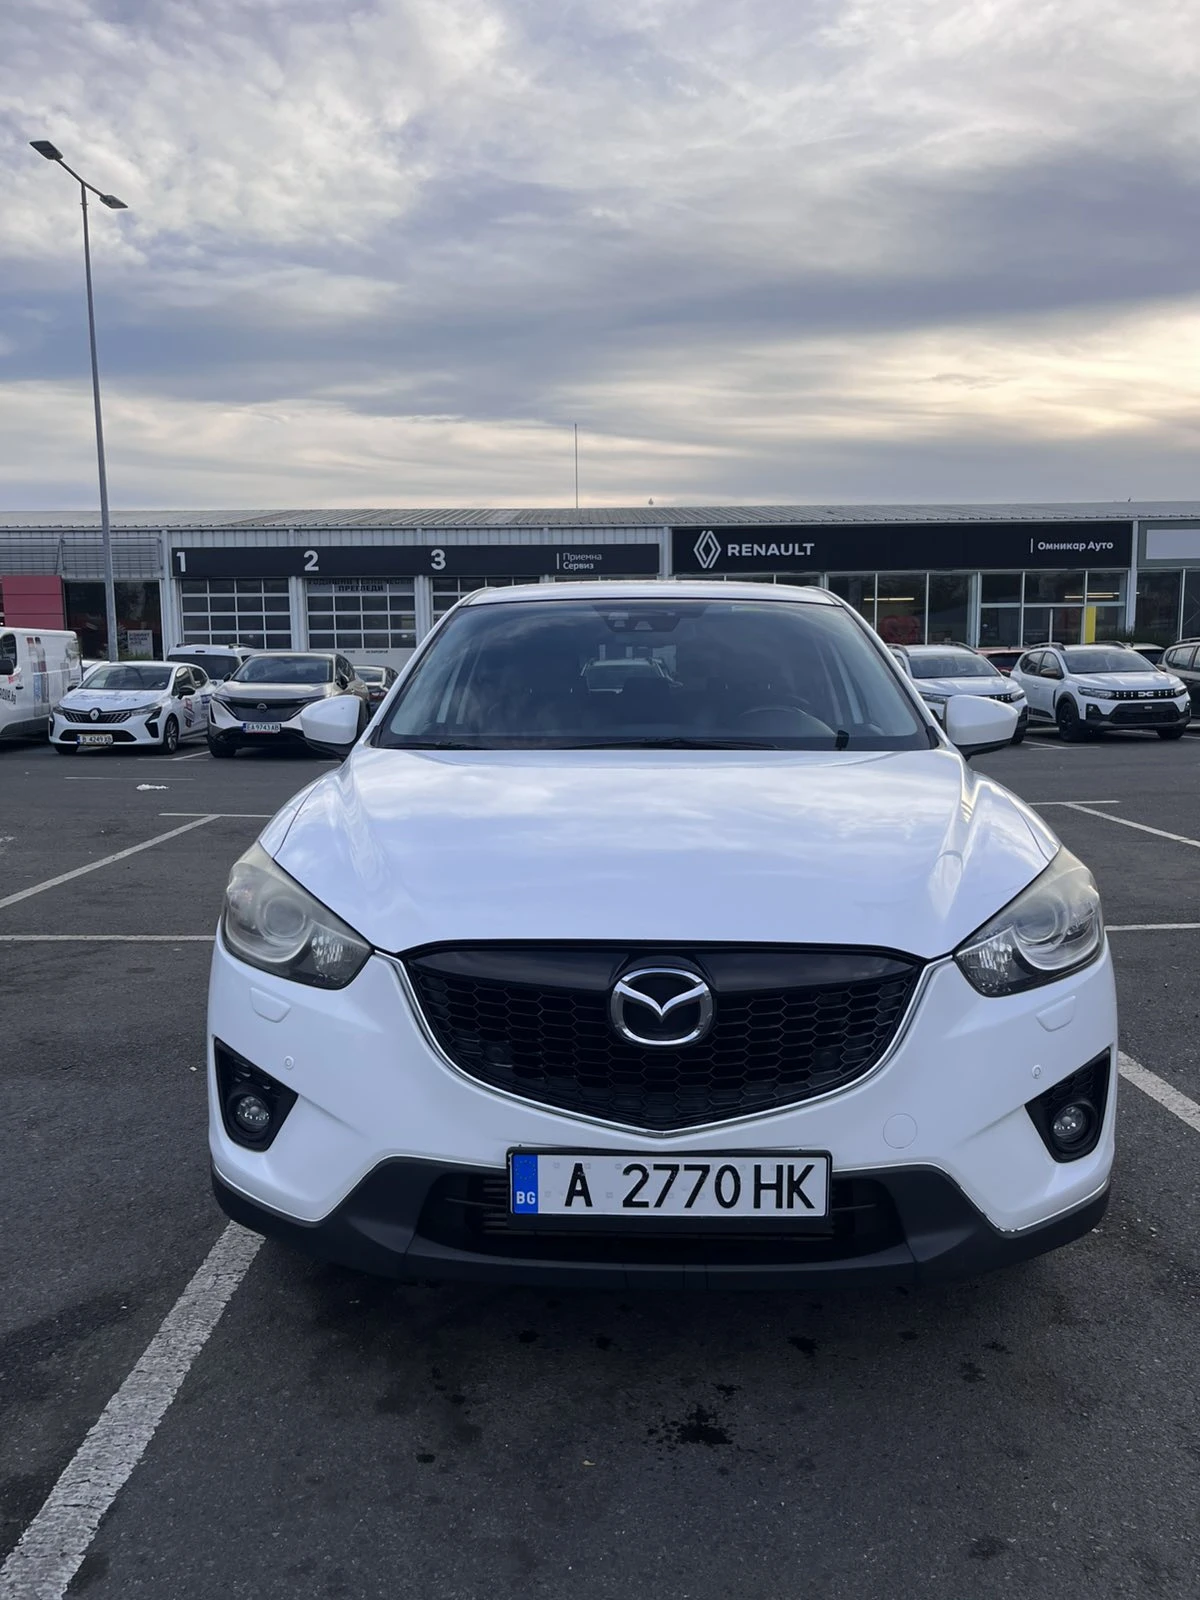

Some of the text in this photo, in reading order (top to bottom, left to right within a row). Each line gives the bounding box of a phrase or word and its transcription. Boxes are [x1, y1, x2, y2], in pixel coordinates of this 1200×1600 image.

[727, 543, 815, 557] RENAULT
[1037, 541, 1114, 552] Омникар Ауто
[176, 551, 187, 573] 1
[303, 550, 319, 572] 2
[430, 549, 446, 570] 3
[563, 553, 602, 562] Приемна
[563, 562, 594, 571] Сервиз
[564, 1163, 816, 1210] A 2770 HK
[516, 1191, 536, 1205] BG
